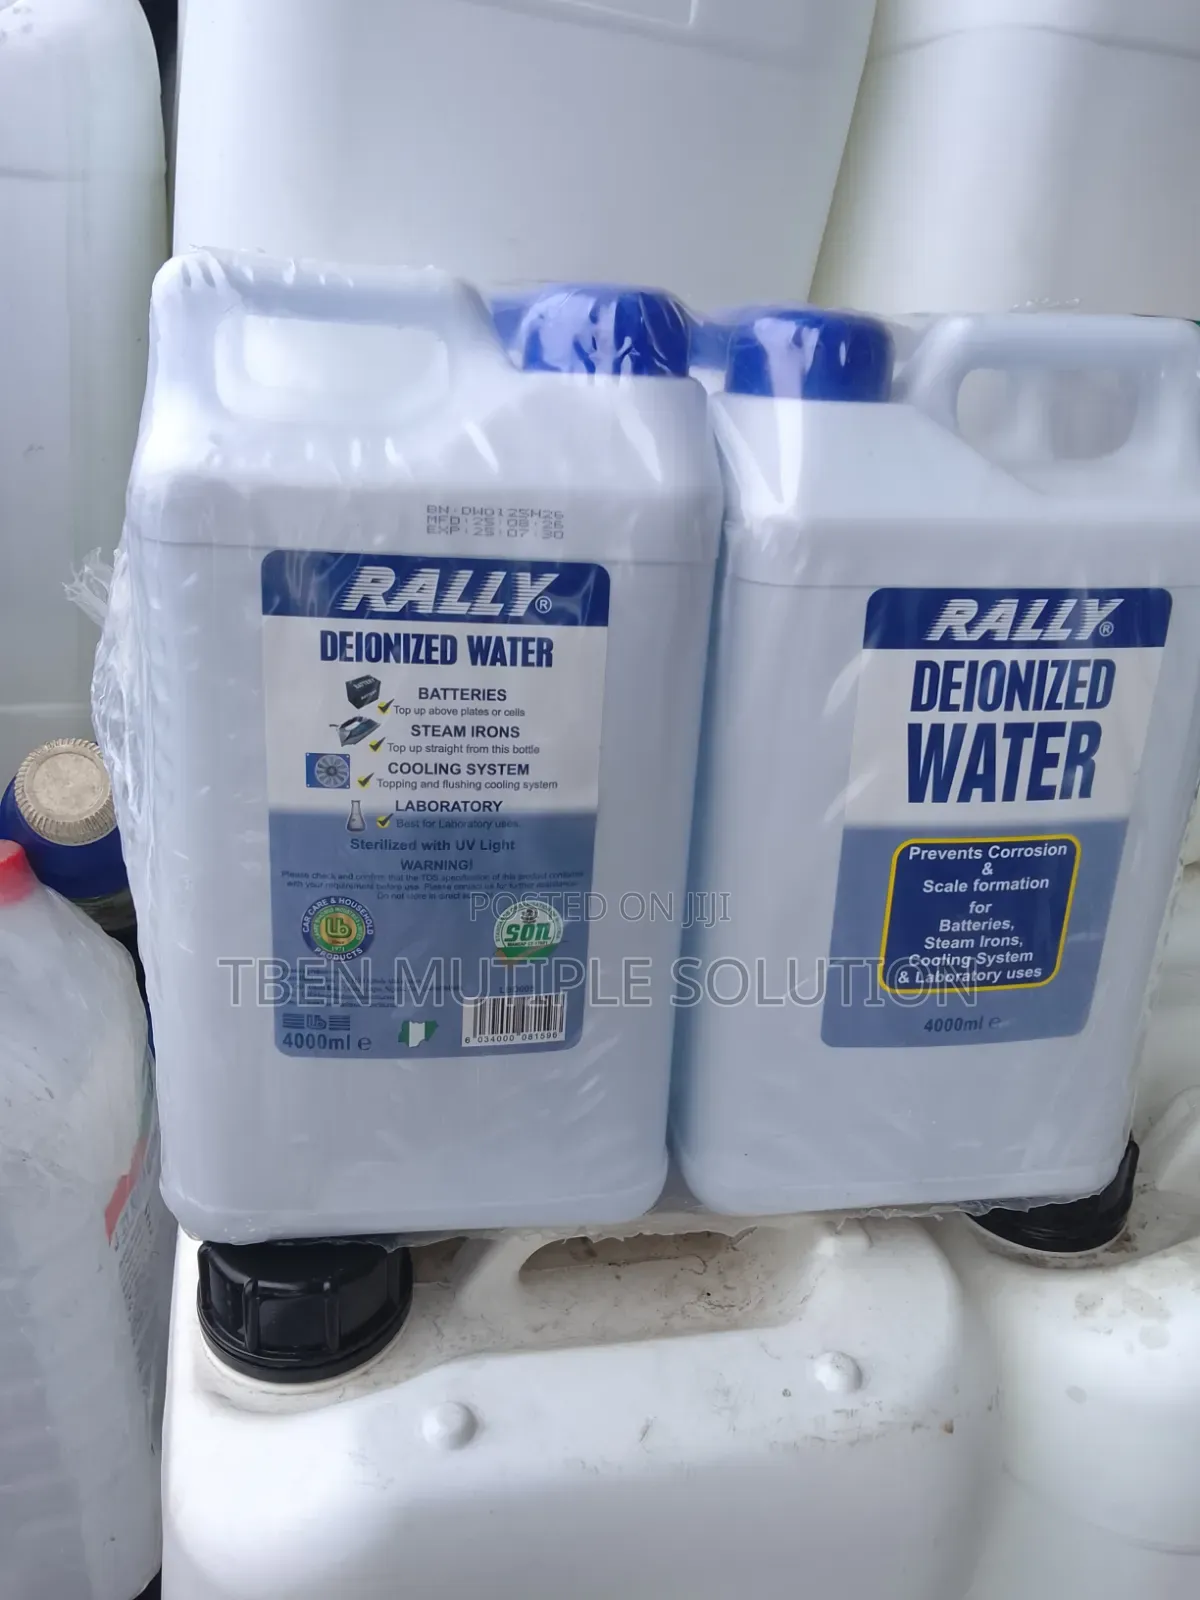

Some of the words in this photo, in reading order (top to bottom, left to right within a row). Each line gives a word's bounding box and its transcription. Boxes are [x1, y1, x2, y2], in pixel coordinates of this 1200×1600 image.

[320, 630, 457, 665] DEIONIZED
[467, 635, 553, 668] WATER
[910, 659, 1117, 712] DEIONIZED
[418, 687, 507, 701] BATTERIES
[394, 705, 411, 716] Top
[414, 707, 426, 716] up
[429, 706, 458, 716] above
[461, 706, 489, 717] plates
[504, 707, 525, 717] cells
[411, 724, 466, 738] STEAM
[471, 725, 520, 738] IRONS
[387, 742, 406, 753] Top
[409, 745, 423, 755] up
[425, 743, 463, 755] straight
[466, 743, 489, 754] from
[492, 744, 510, 754] this
[512, 744, 540, 754] bottle
[388, 762, 461, 776] COOLING
[466, 763, 529, 776] SYSTEM
[907, 721, 1103, 803] WATER
[377, 779, 417, 791] Topping
[420, 779, 439, 789] and
[443, 779, 482, 791] flushing
[485, 780, 520, 791] cooling
[523, 781, 558, 791] system
[395, 800, 503, 812] LABORATORY
[396, 819, 420, 829] Best
[422, 819, 436, 828] for
[439, 819, 492, 831] Laboratory
[350, 838, 417, 851] Sterilized
[421, 839, 450, 851] with
[455, 840, 476, 851] UV
[480, 839, 515, 853] Light
[908, 845, 983, 861] Prevents
[988, 843, 1068, 859] Corrosion
[400, 859, 473, 872] WARNING!
[981, 862, 994, 876] &
[338, 872, 354, 880] and
[406, 873, 419, 881] the
[922, 878, 969, 894] Scale
[973, 876, 1050, 892] formation
[391, 892, 404, 900] not
[968, 901, 992, 915] for
[302, 916, 312, 933] CAR
[308, 899, 329, 916] CARE
[338, 897, 374, 935] HOUSEHOLD
[939, 917, 1015, 934] Batteries,
[924, 935, 975, 950] Steam
[979, 934, 1024, 950] Irons,
[314, 946, 364, 961] PRODUCTS
[908, 953, 972, 969] Cooling
[976, 950, 1034, 967] System
[898, 970, 910, 984] &
[915, 967, 1002, 984] Laboratory
[1006, 967, 1043, 980] uses
[924, 1014, 983, 1033] 4000ml
[282, 1032, 350, 1050] 4000ml
[478, 1035, 515, 1043] 034000
